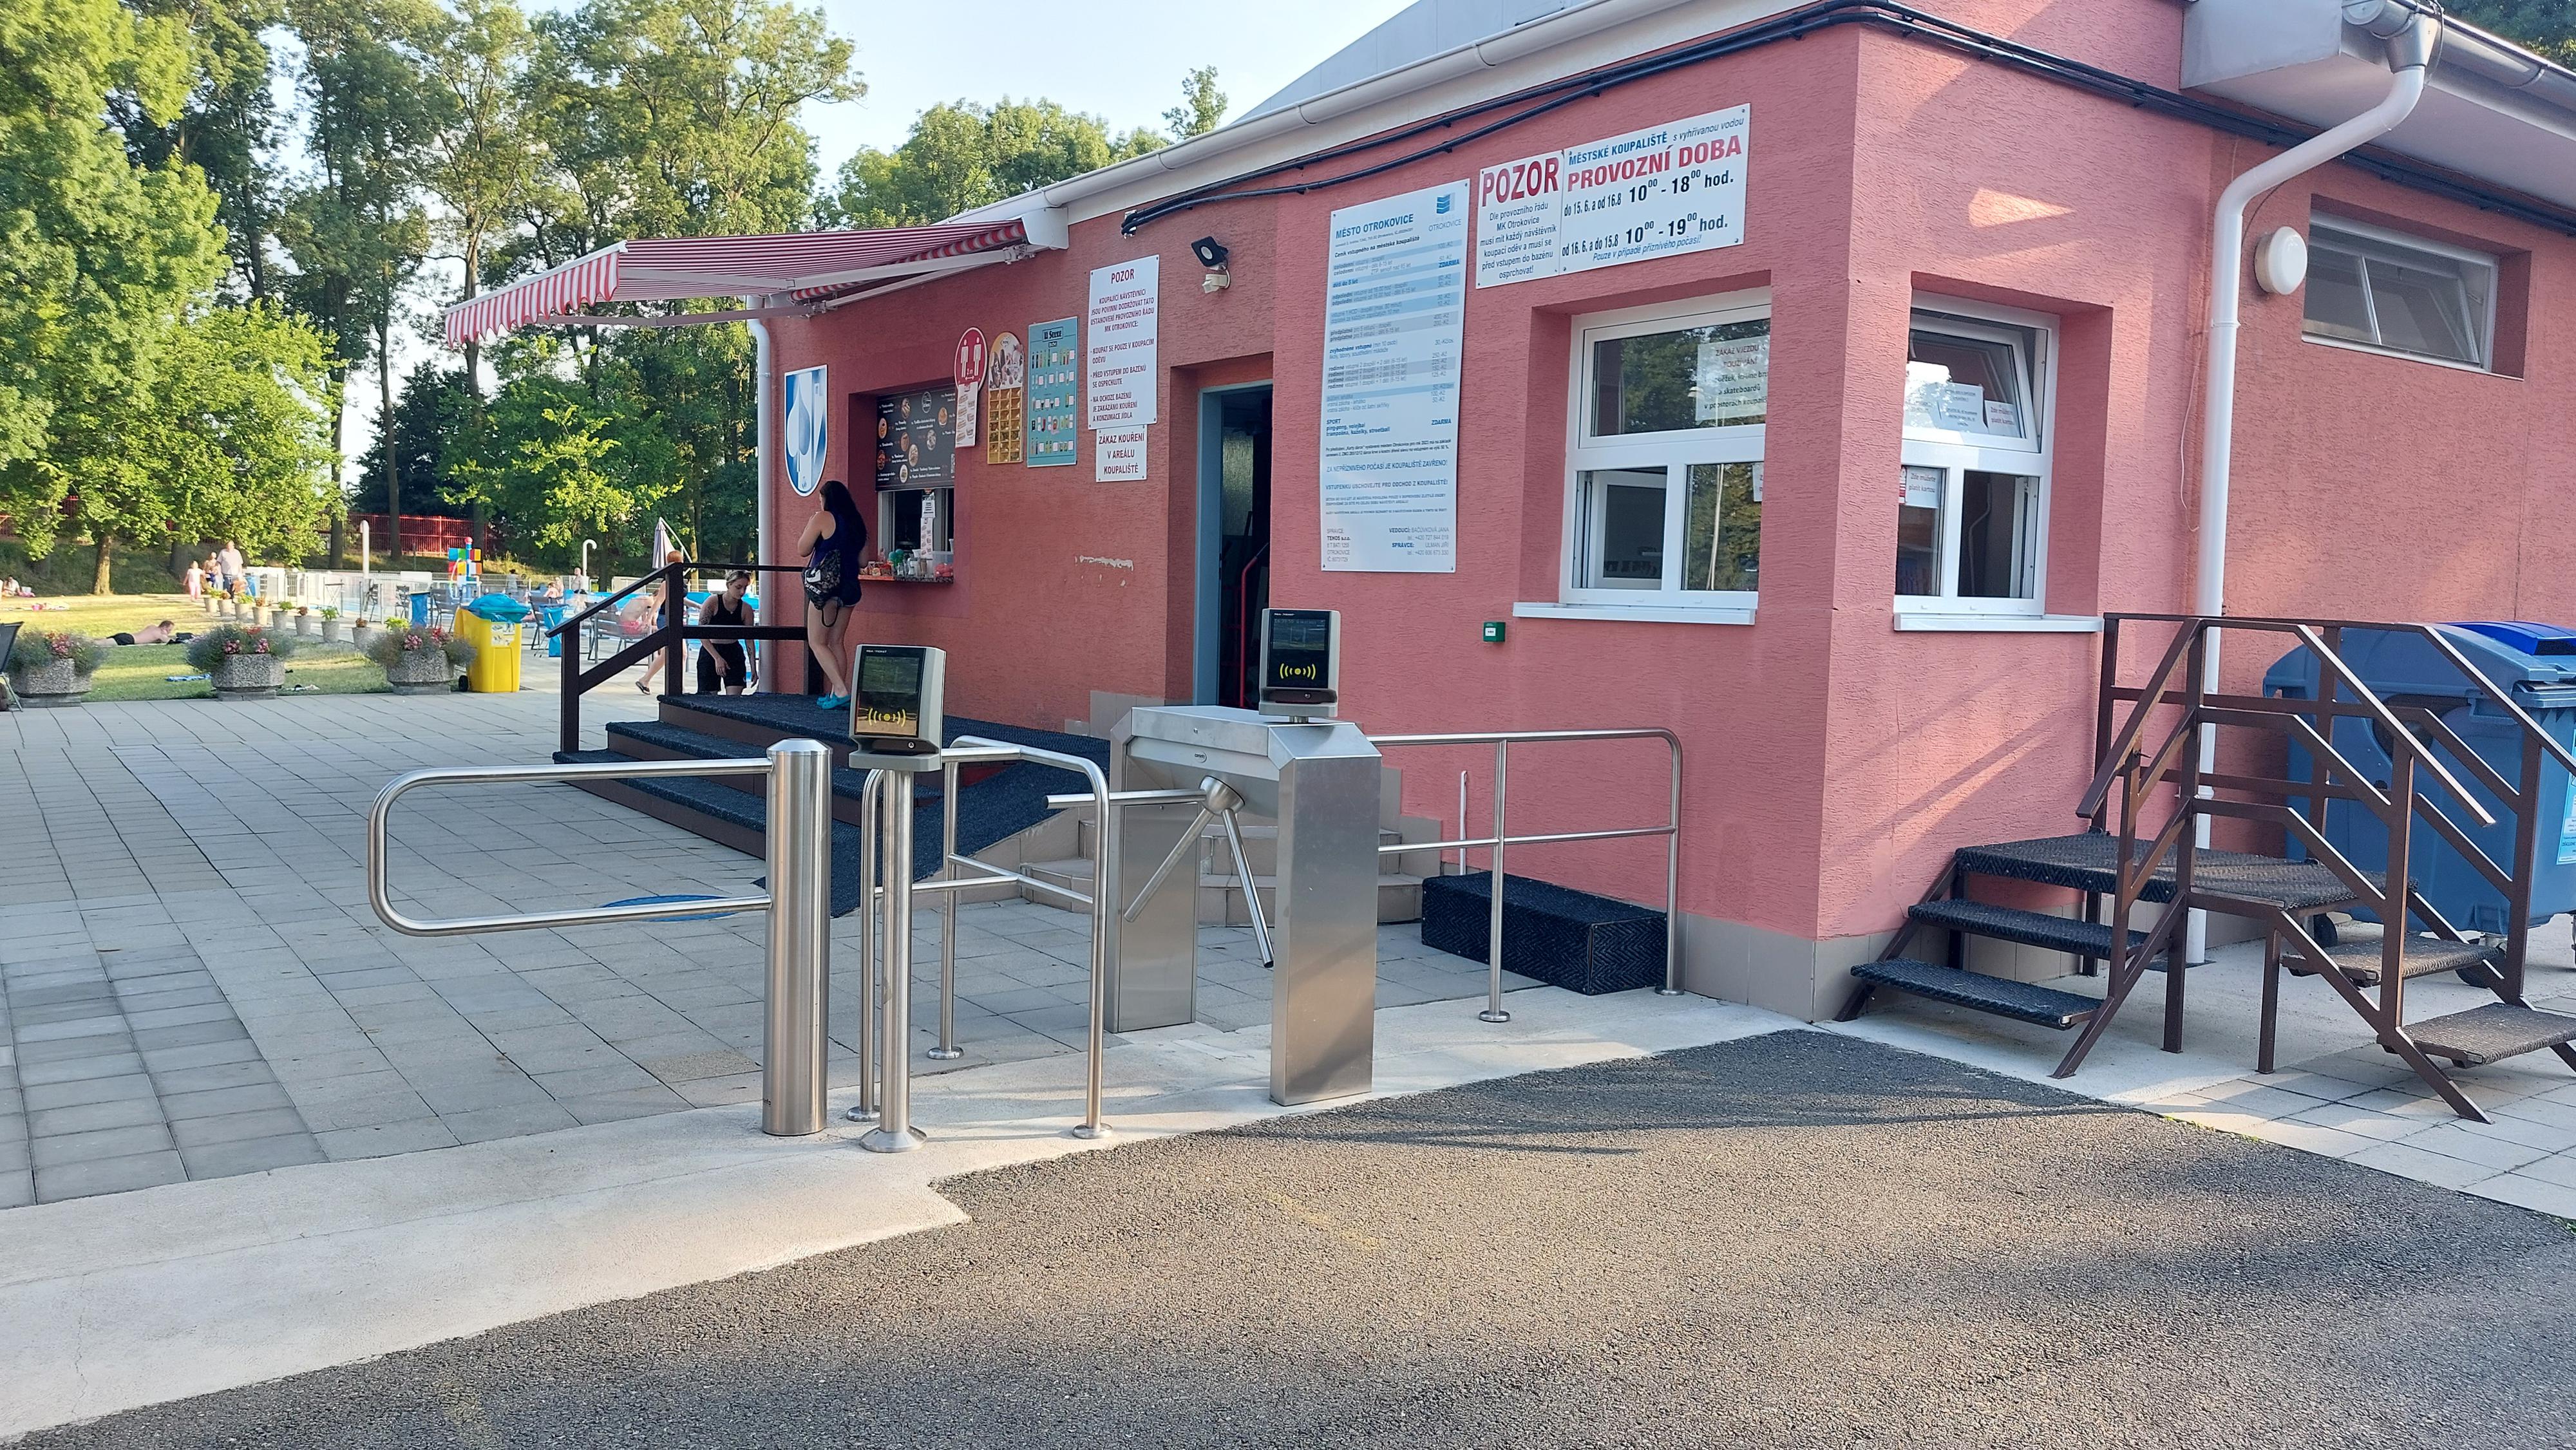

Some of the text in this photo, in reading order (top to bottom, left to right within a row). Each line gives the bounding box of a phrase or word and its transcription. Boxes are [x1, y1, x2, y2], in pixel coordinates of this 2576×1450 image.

[1569, 145, 1609, 165] MĚSTSKÉ
[1611, 131, 1667, 155] KOUPALIŠTĚ
[1721, 118, 1745, 129] vodou
[1568, 135, 1741, 191] PROVOZNÍ DOBA
[1482, 158, 1558, 206] POZOR
[1564, 203, 1572, 216] do
[1573, 201, 1583, 214] 15.
[1584, 199, 1590, 212] 6.
[1591, 200, 1596, 211] a
[1597, 196, 1605, 210] od
[1607, 193, 1622, 207] 16.8
[1705, 170, 1734, 188] hod.
[1490, 212, 1499, 221] Dle
[1336, 225, 1361, 239] MĚSTO
[1363, 214, 1414, 232] OTROKOVICE
[1428, 218, 1461, 232] OTROKOVICE
[1497, 216, 1540, 231] MK Otrokovice
[1396, 236, 1420, 245] koupaliště
[1506, 231, 1522, 241] každý
[1562, 243, 1569, 256] od
[1571, 241, 1580, 255] 16.
[1582, 240, 1587, 252] 6.
[1589, 241, 1593, 252] a
[1595, 237, 1603, 250] do
[1605, 234, 1618, 248] 15.8
[1700, 214, 1728, 232] hod.
[1507, 243, 1522, 253] oděv
[1482, 250, 1553, 272] před vstupem do bazénu
[1593, 252, 1611, 261] Pouze
[1439, 259, 1459, 268] ZDARMA
[1111, 268, 1135, 284] POZOR
[1499, 265, 1534, 279] osprchovat!
[1101, 304, 1118, 313] POVINNI
[1118, 299, 1143, 310] DODRŽOVAT
[1143, 297, 1155, 305] TATO
[1112, 320, 1139, 331] OTROKOVICE:
[1093, 346, 1108, 355] KOUPAT
[1114, 343, 1128, 351] POUZE
[1132, 338, 1155, 348] KOUPACÍM
[1715, 347, 1735, 357] ZÁKAZ
[1736, 344, 1759, 353] VJEZDU
[1092, 356, 1106, 364] ODĚVU
[1092, 370, 1103, 379] PŘED
[1103, 368, 1122, 377] VSTUPEM
[1098, 378, 1122, 388] OSPRCHUJTE
[1723, 383, 1761, 395] skateboardů
[1099, 393, 1115, 402] OCHOZE
[1119, 400, 1138, 410] KOUŘENÍ
[1096, 413, 1121, 422] KONZUMACE
[1099, 431, 1144, 445] ZÁKAZ KOUŘENÍ
[1107, 447, 1135, 459] V AREÁLU
[1104, 462, 1139, 475] KOUPALIŠTĚ
[1392, 460, 1422, 469] KOUPALIŠTĚ
[1422, 458, 1448, 467] ZAVŘENO!
